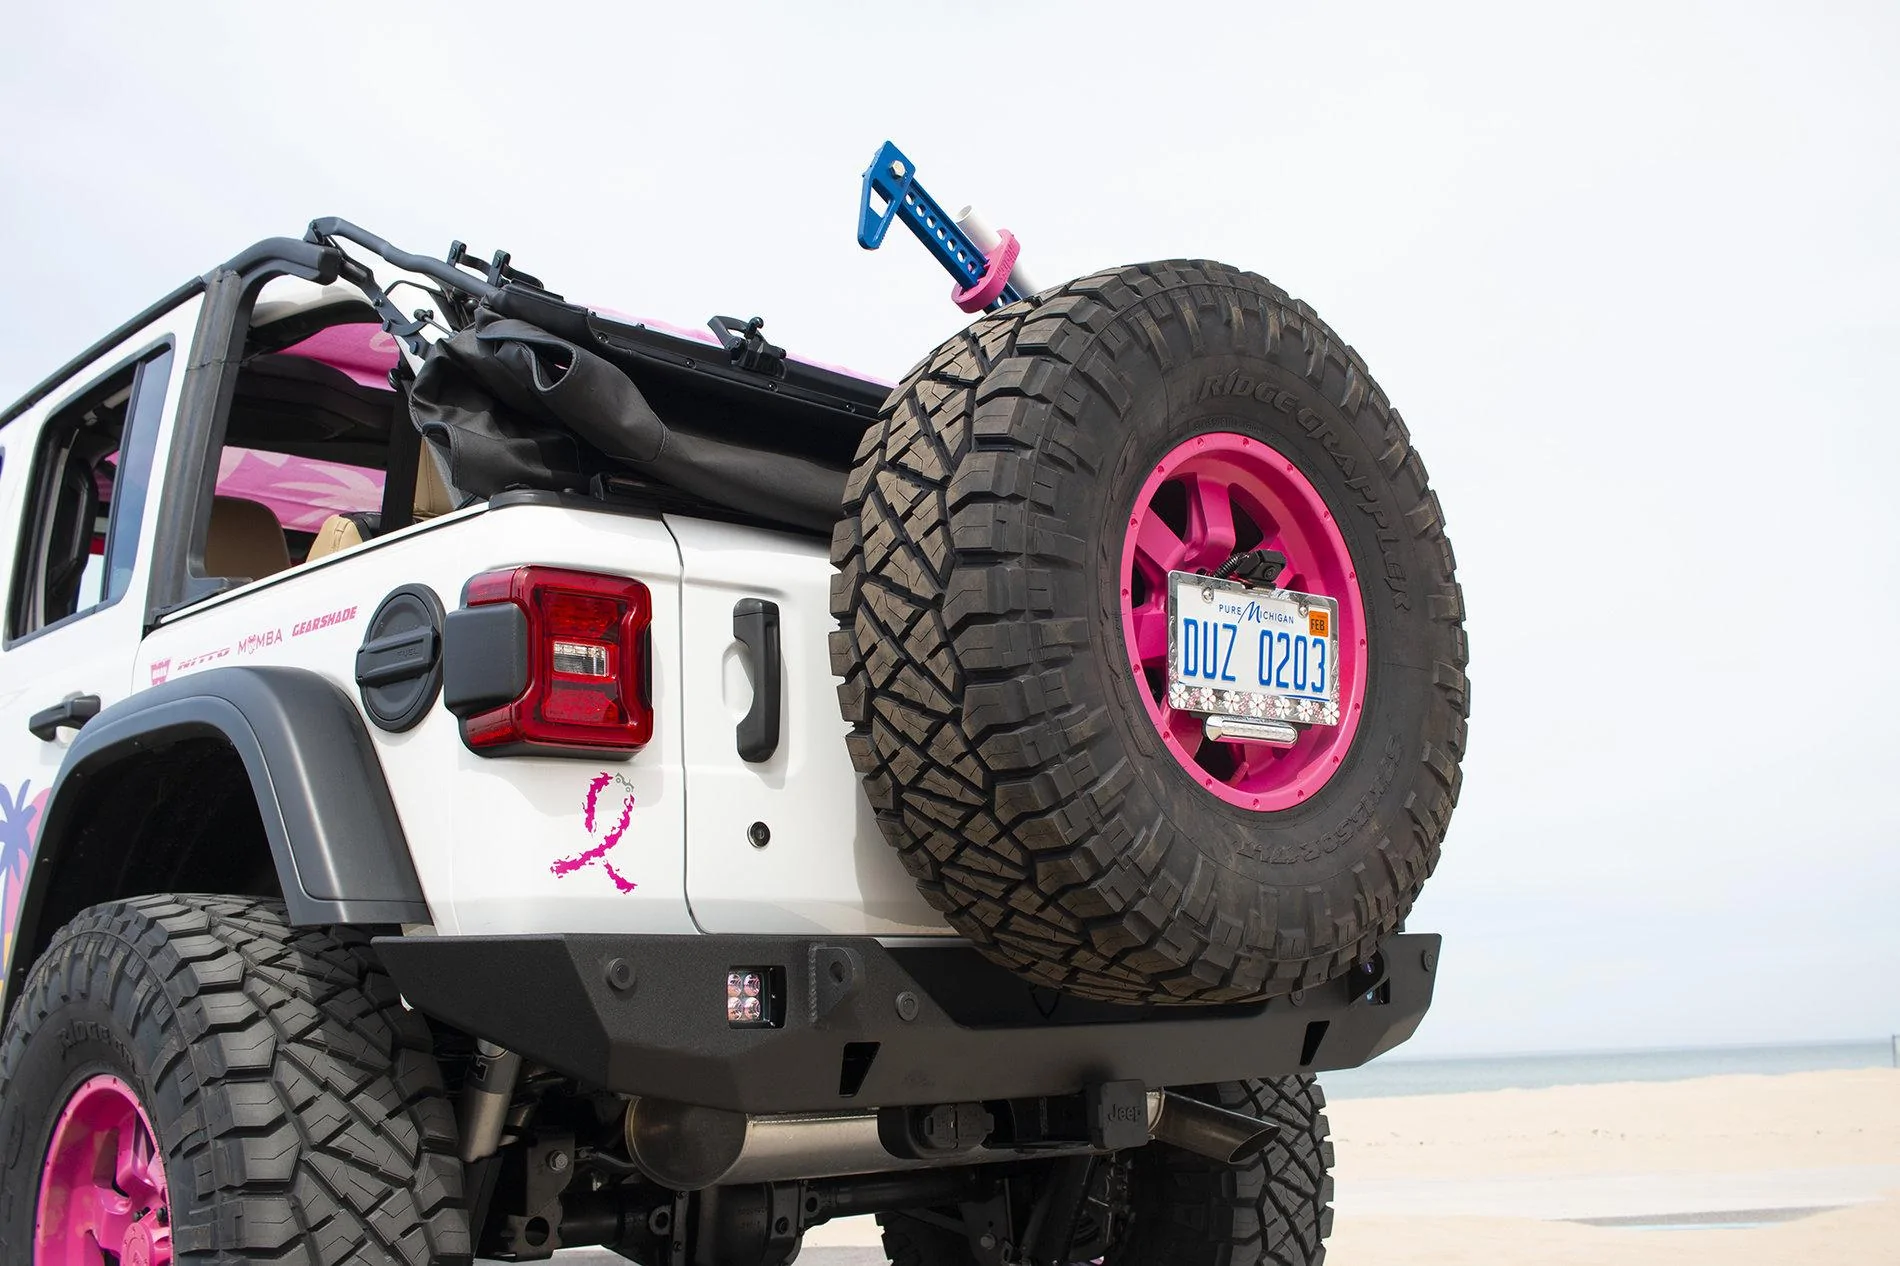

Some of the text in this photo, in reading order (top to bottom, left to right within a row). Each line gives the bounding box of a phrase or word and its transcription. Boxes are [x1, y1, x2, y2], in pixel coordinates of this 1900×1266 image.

[1197, 368, 1301, 414] RIDGE
[1297, 406, 1412, 613] GRAPPLER
[292, 605, 358, 637] GEARSHADE
[1218, 601, 1295, 624] PURE MICHIGAN
[1310, 619, 1325, 631] FEB
[1183, 617, 1326, 694] DUZ 0203
[1107, 1103, 1142, 1124] Jeep
